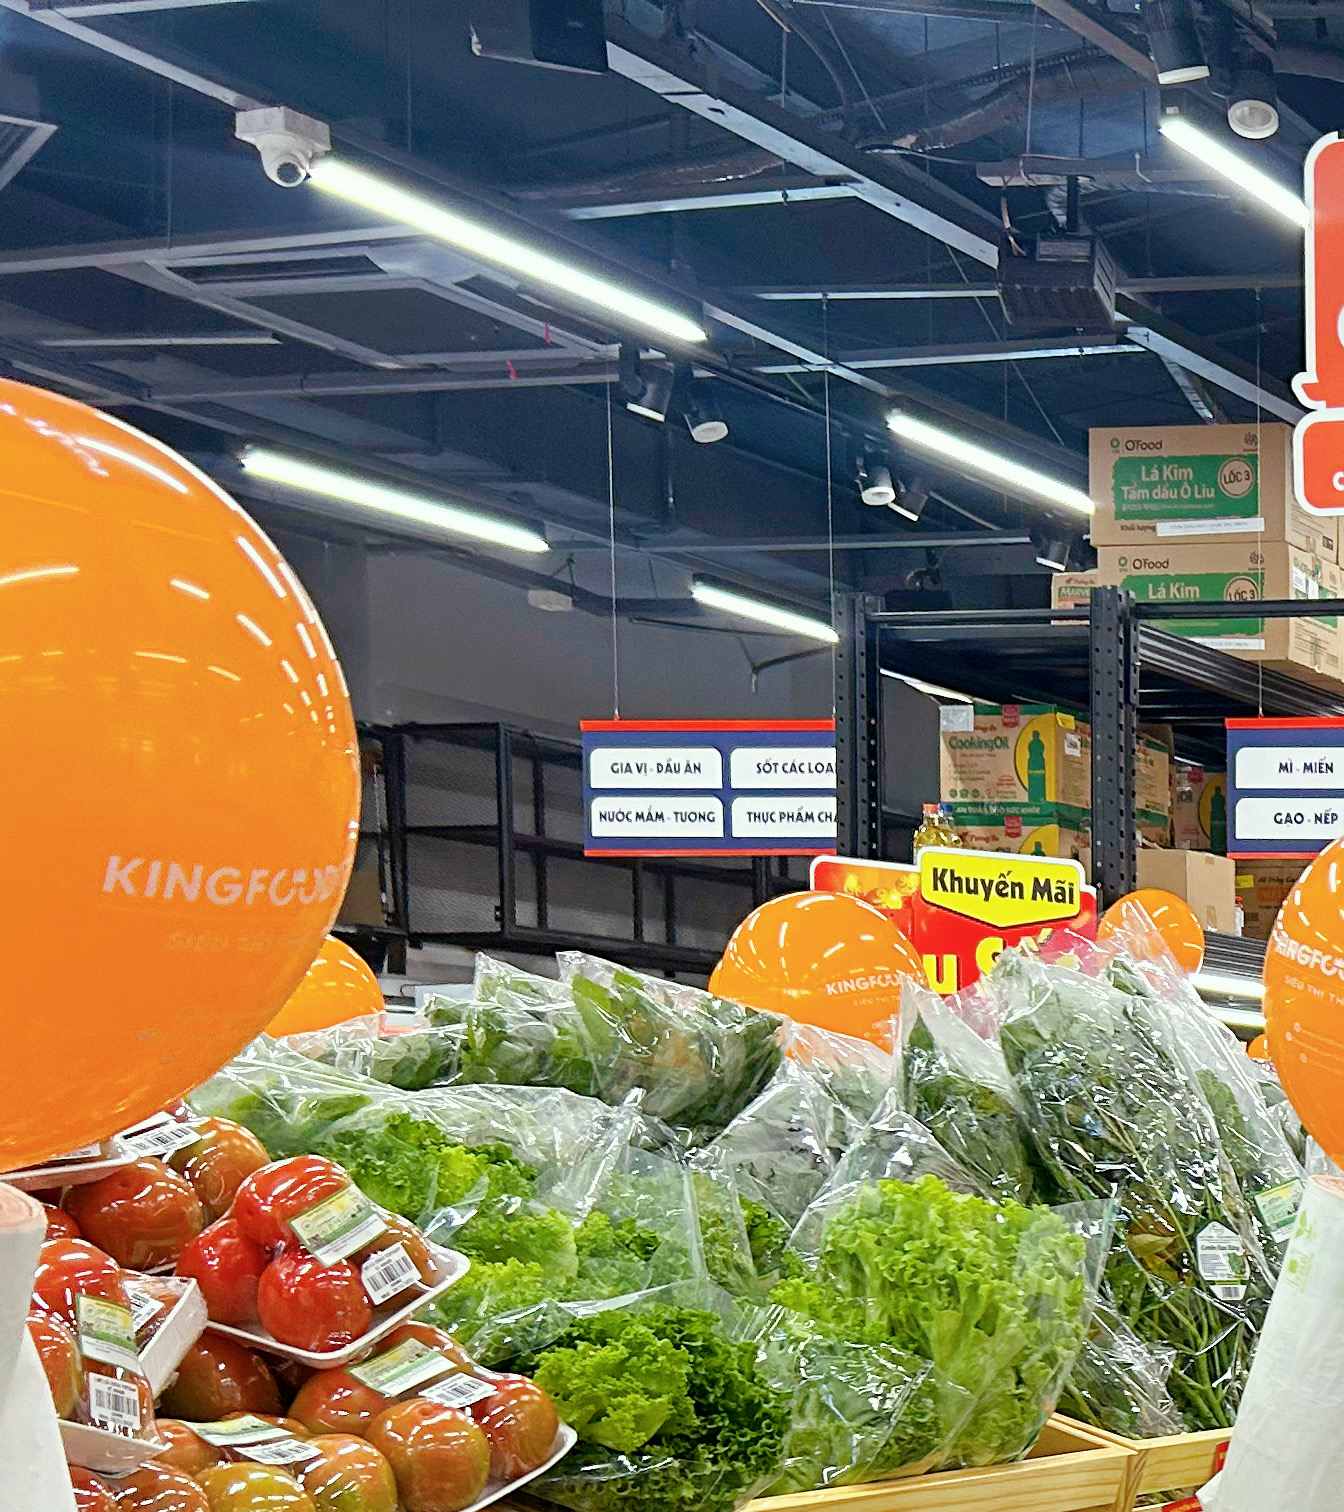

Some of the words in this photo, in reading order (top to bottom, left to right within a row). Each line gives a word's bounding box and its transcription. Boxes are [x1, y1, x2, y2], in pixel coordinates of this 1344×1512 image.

[1141, 466, 1158, 482] Lá
[1163, 465, 1193, 480] Kim
[1224, 470, 1243, 485] LỐC
[1244, 470, 1250, 481] 3
[1194, 485, 1215, 498] Liu
[1148, 584, 1166, 599] Lá
[1170, 583, 1200, 599] Kim
[1249, 588, 1255, 599] 3
[611, 762, 633, 774] GIA
[636, 762, 647, 776] VỊ
[657, 758, 681, 774] DẦU
[684, 761, 701, 774] ĂN
[756, 757, 779, 774] SỐT
[782, 760, 805, 774] CÁC
[1278, 757, 1293, 775] MÌ
[1303, 756, 1334, 775] MIẾN
[599, 807, 632, 823] NƯỚC
[635, 804, 664, 823] MẮM
[747, 811, 776, 825] THỰC
[779, 806, 814, 823] PHẨM
[1273, 811, 1304, 828] GẠO
[1313, 806, 1339, 825] NẾP
[933, 867, 1024, 902] Khuyến
[1032, 876, 1075, 906] Mãi
